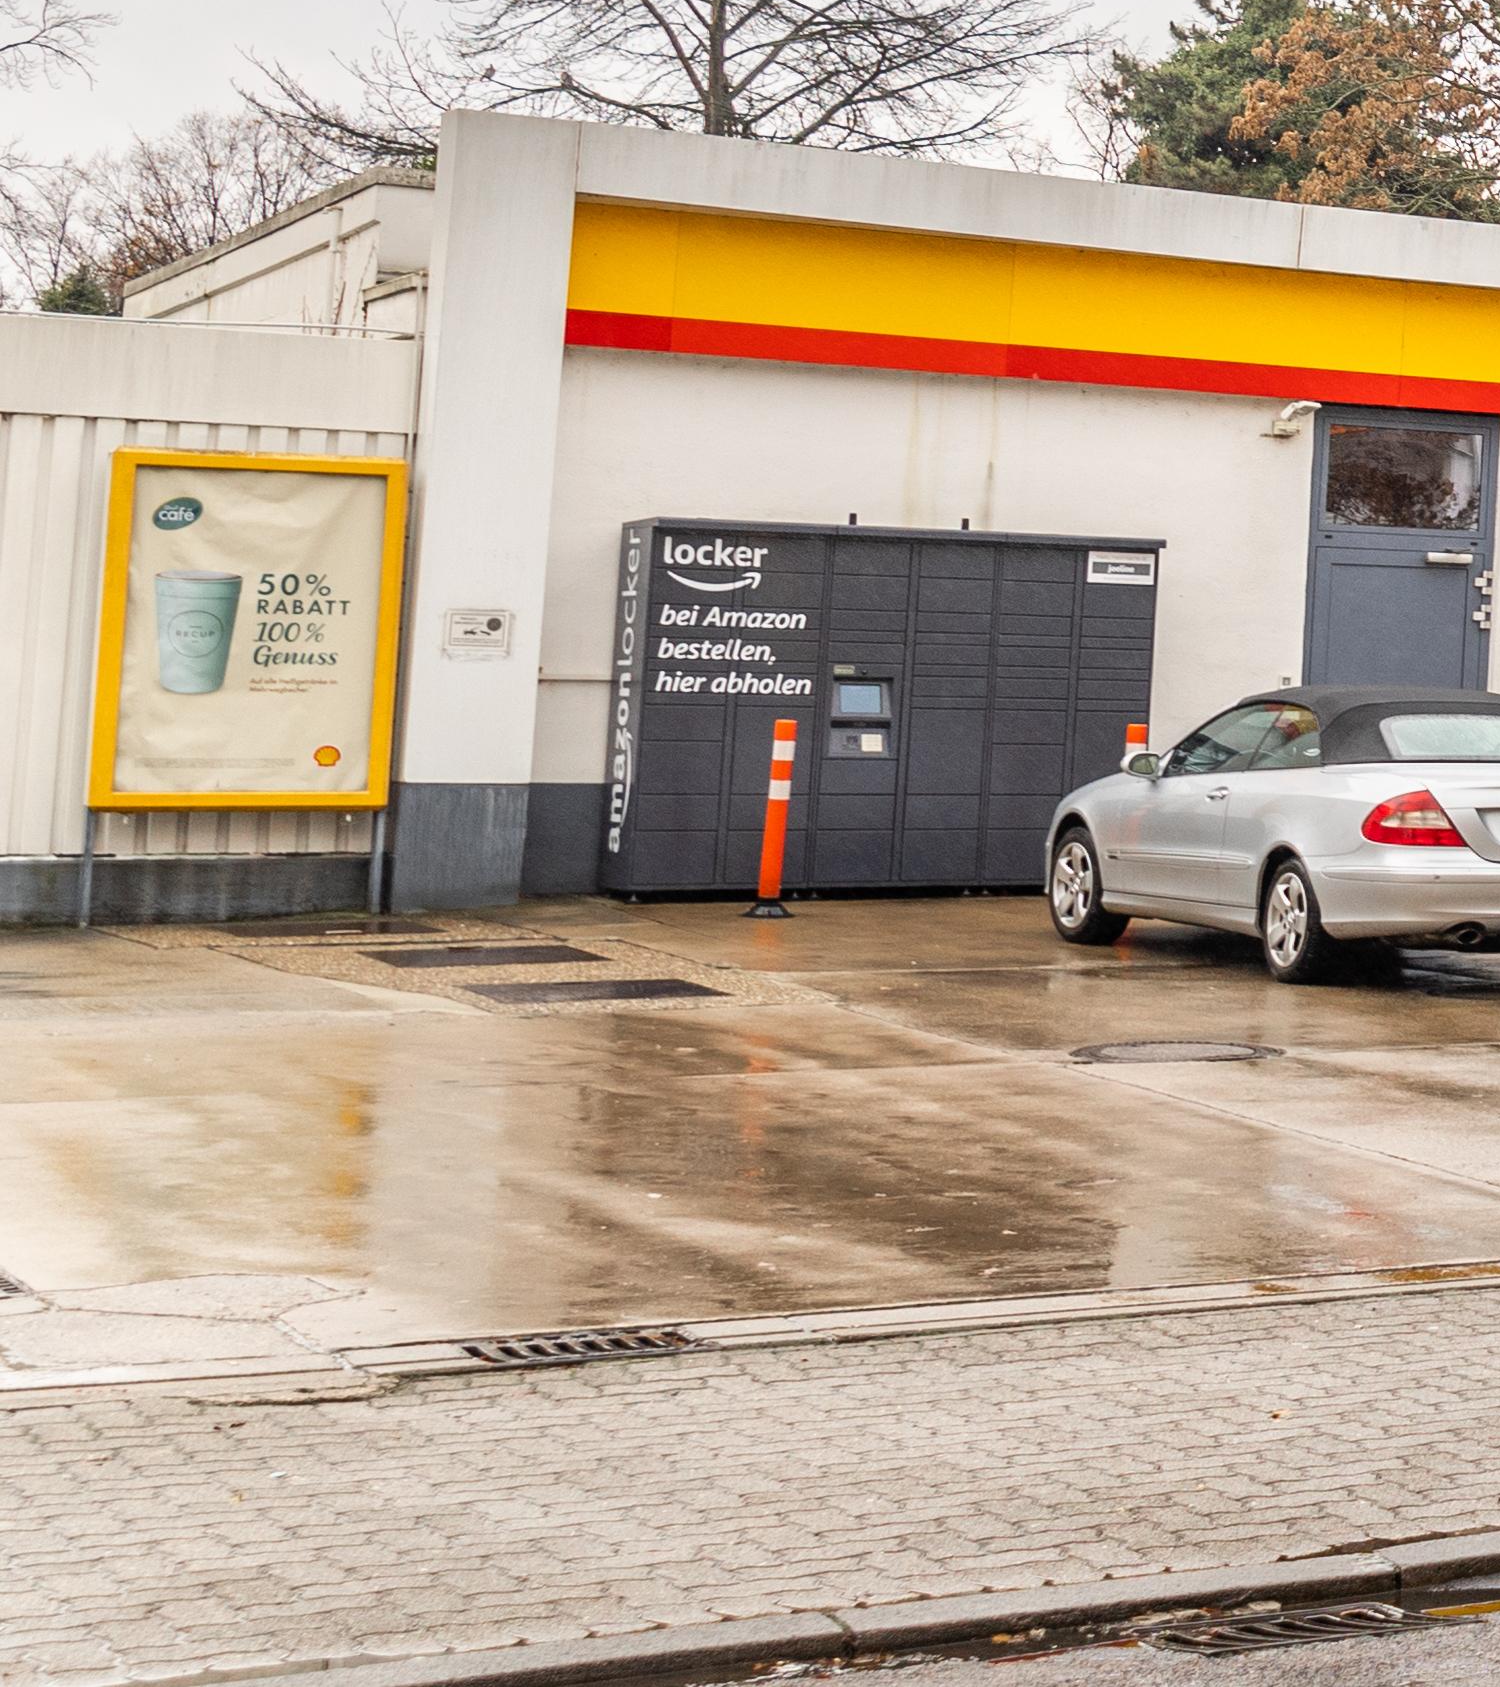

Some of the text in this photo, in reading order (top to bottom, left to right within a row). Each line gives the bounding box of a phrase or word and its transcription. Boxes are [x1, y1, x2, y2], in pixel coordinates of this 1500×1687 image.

[663, 536, 769, 568] locker
[256, 599, 351, 616] RABATT
[659, 603, 808, 630] bei Amazon
[253, 644, 340, 668] Genuss
[657, 637, 777, 666] bestellen,
[654, 670, 813, 695] hier abholen
